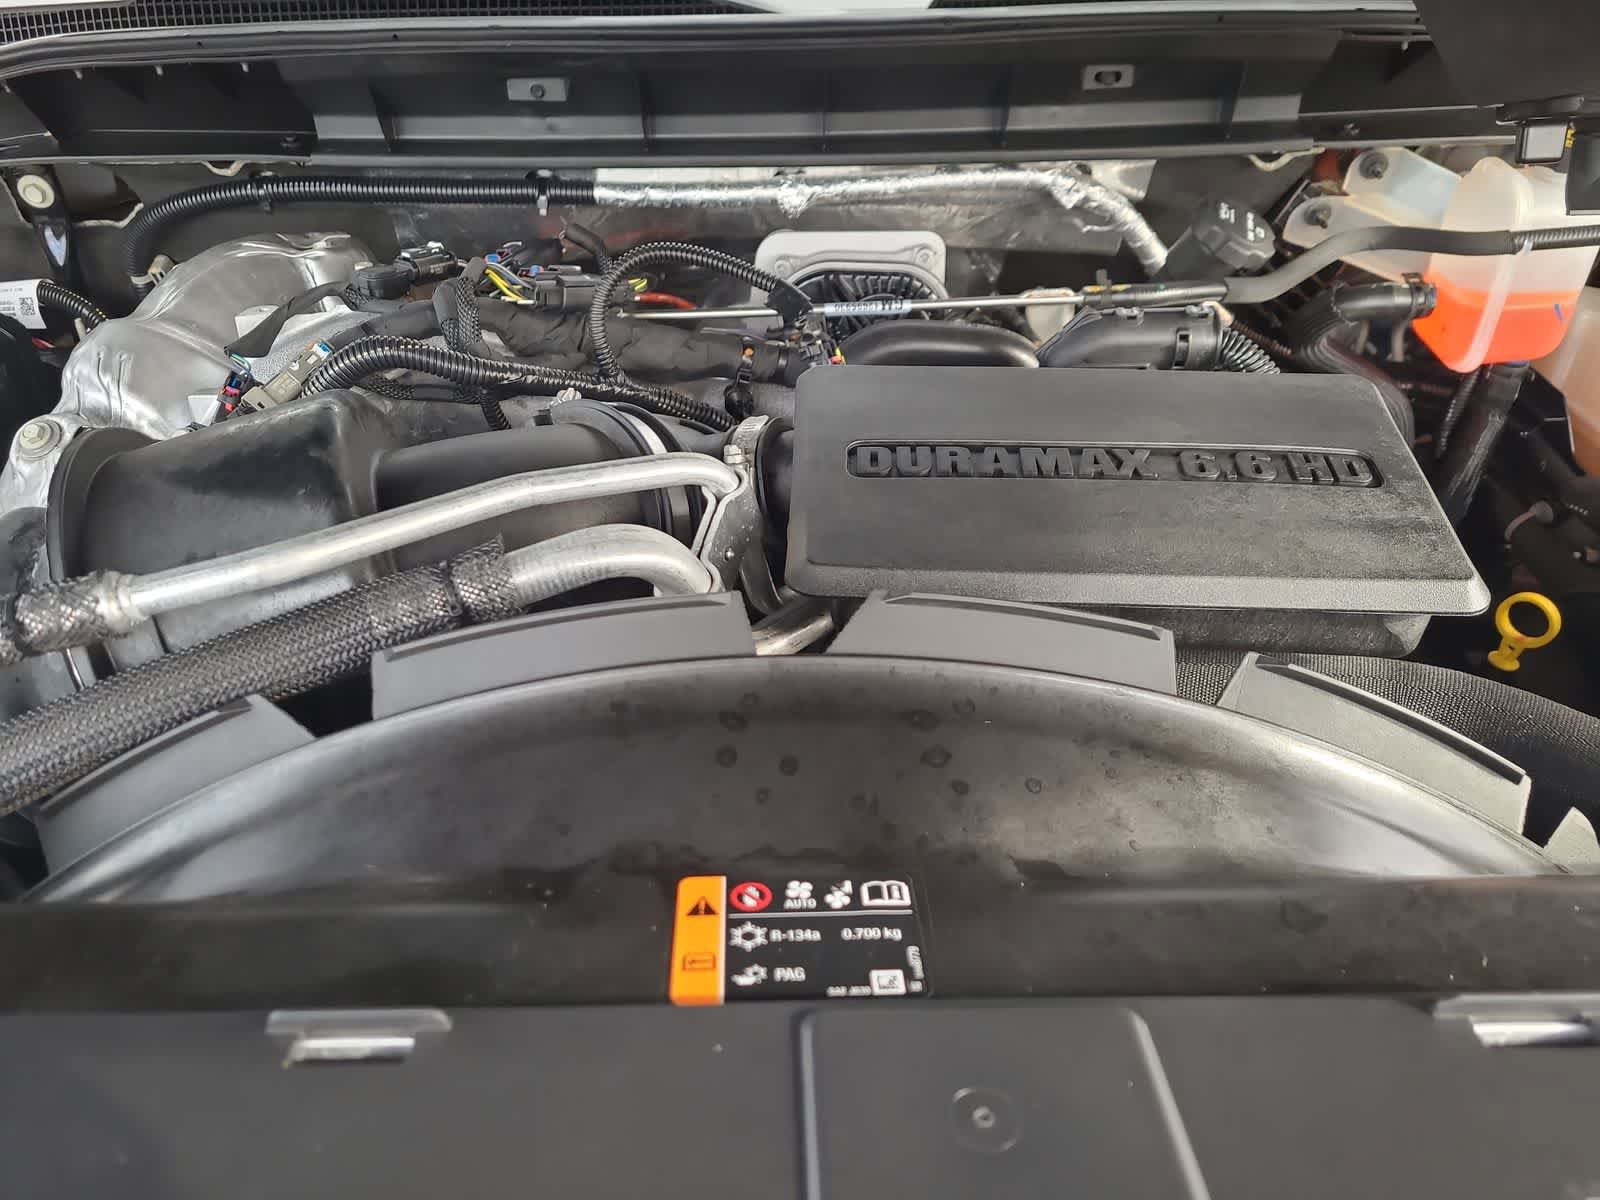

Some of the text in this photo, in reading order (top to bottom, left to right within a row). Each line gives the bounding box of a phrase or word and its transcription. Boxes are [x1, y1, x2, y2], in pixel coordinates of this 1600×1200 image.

[856, 445, 1374, 486] DURAMAX 6.6 HD
[784, 898, 817, 909] AUTO
[769, 927, 903, 942] R-134a 0.700 kg
[773, 967, 806, 981] PAG
